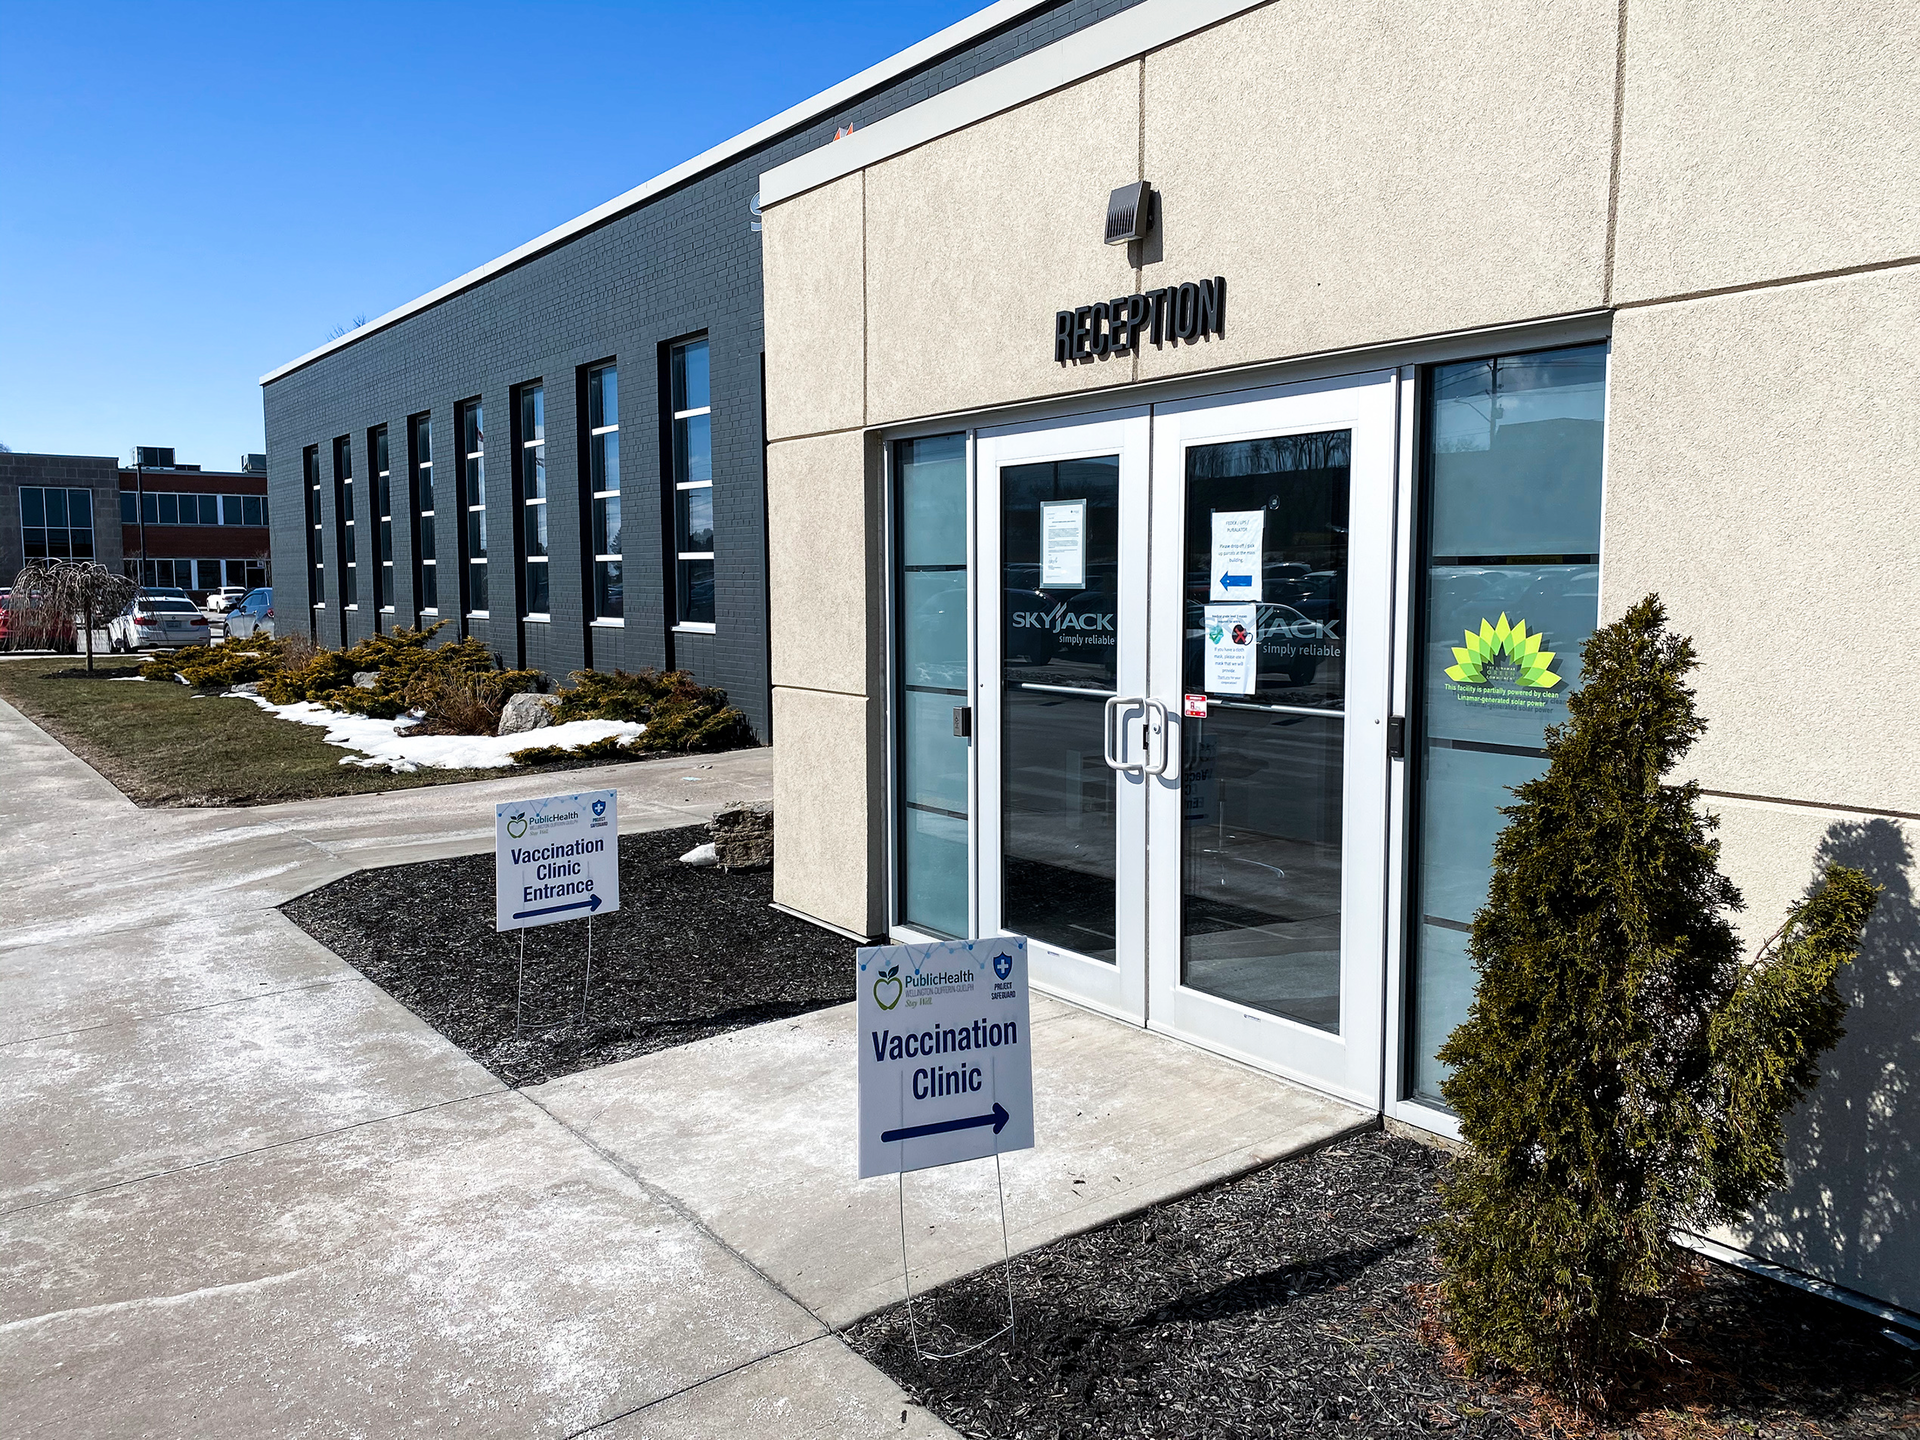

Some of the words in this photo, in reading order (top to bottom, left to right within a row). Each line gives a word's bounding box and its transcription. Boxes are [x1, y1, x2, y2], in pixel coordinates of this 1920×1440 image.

[1054, 275, 1227, 363] RECEPTION
[1012, 601, 1115, 634] SKYJACK
[1059, 634, 1084, 646] simply
[1084, 634, 1116, 646] reliable
[1262, 643, 1298, 658] simply
[1299, 644, 1341, 657] reliable
[1458, 684, 1476, 694] facility
[1483, 687, 1506, 696] partially
[1533, 690, 1541, 698] by
[529, 811, 579, 825] PublicHealth
[510, 838, 604, 865] Vaccination
[536, 860, 581, 880] Clinic
[524, 879, 594, 902] Entrance
[905, 970, 974, 988] PublicHealth
[994, 982, 1013, 991] PROJECT
[990, 990, 1016, 1000] SAFEGUARD
[872, 1018, 1018, 1062] Vaccination
[912, 1062, 982, 1100] Clinic
